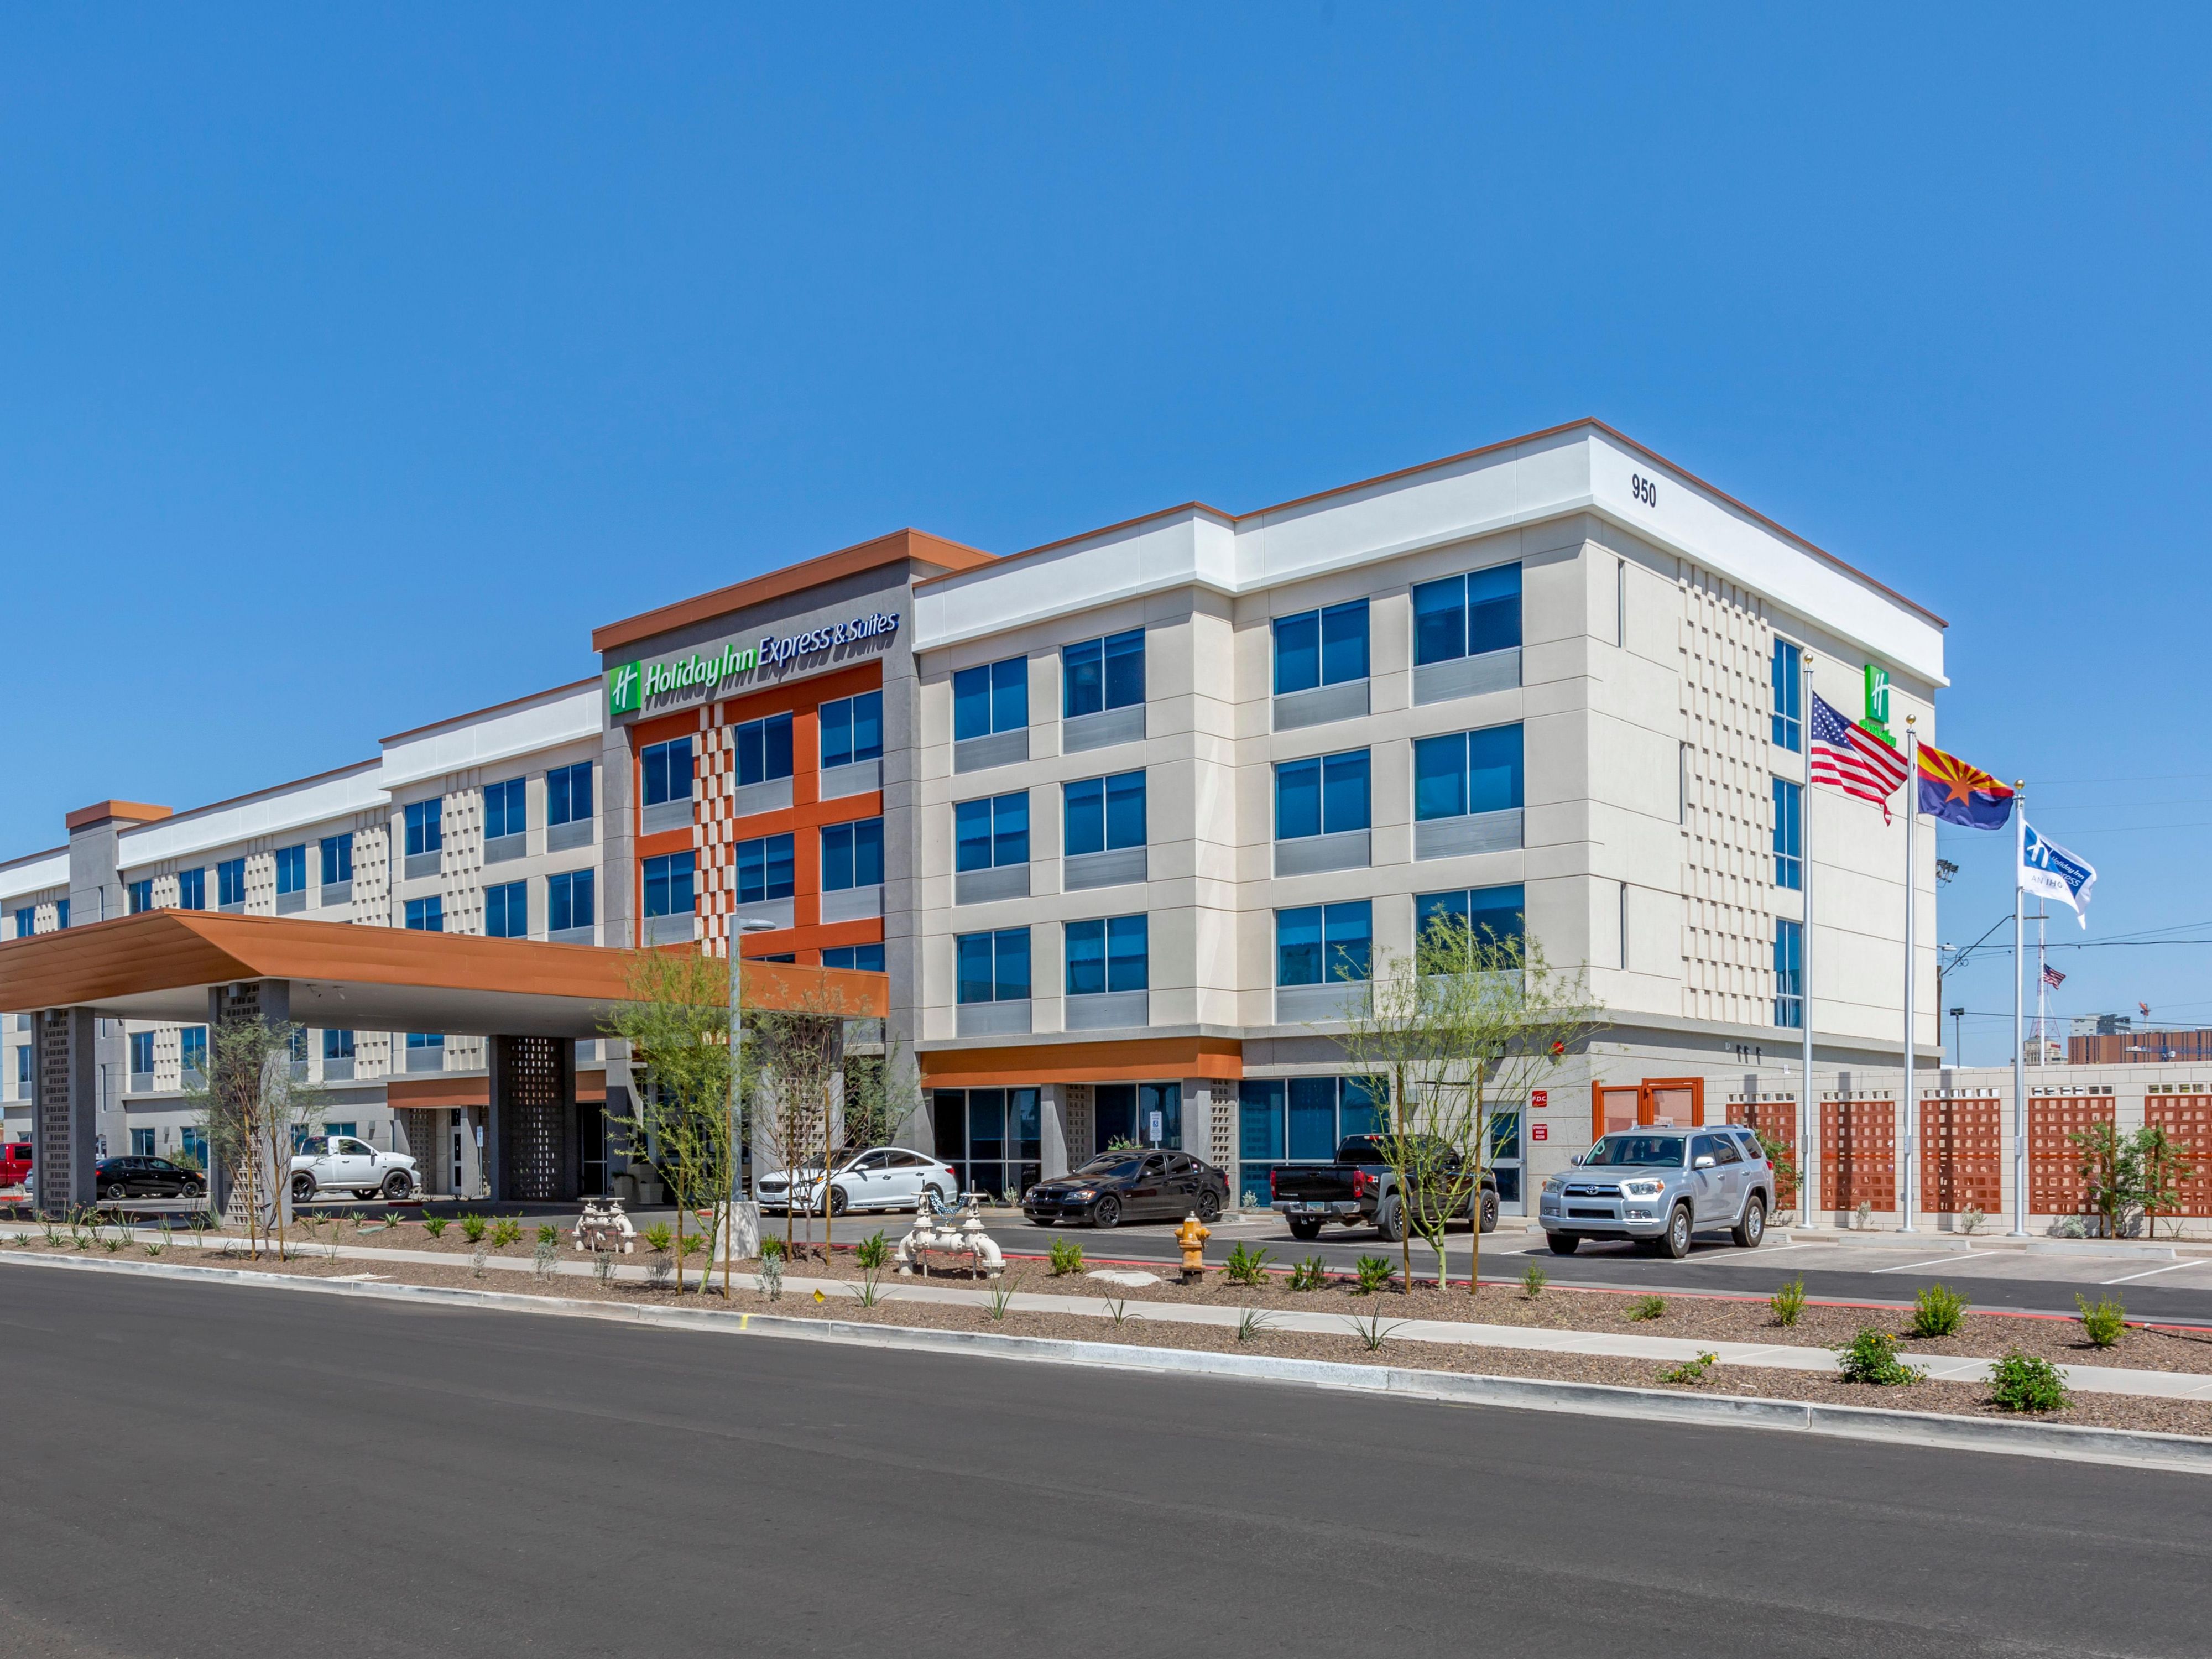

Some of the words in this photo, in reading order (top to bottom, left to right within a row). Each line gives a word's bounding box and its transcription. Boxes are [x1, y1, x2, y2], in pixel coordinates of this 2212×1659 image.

[1632, 473, 1657, 508] 950
[645, 654, 723, 696] Holiday
[722, 644, 758, 676] Inn
[758, 627, 833, 667] Express
[834, 623, 849, 645] &
[849, 613, 900, 641] Suites
[2031, 875, 2043, 884] AN
[2046, 878, 2063, 888] IHG
[2073, 870, 2085, 879] Inn
